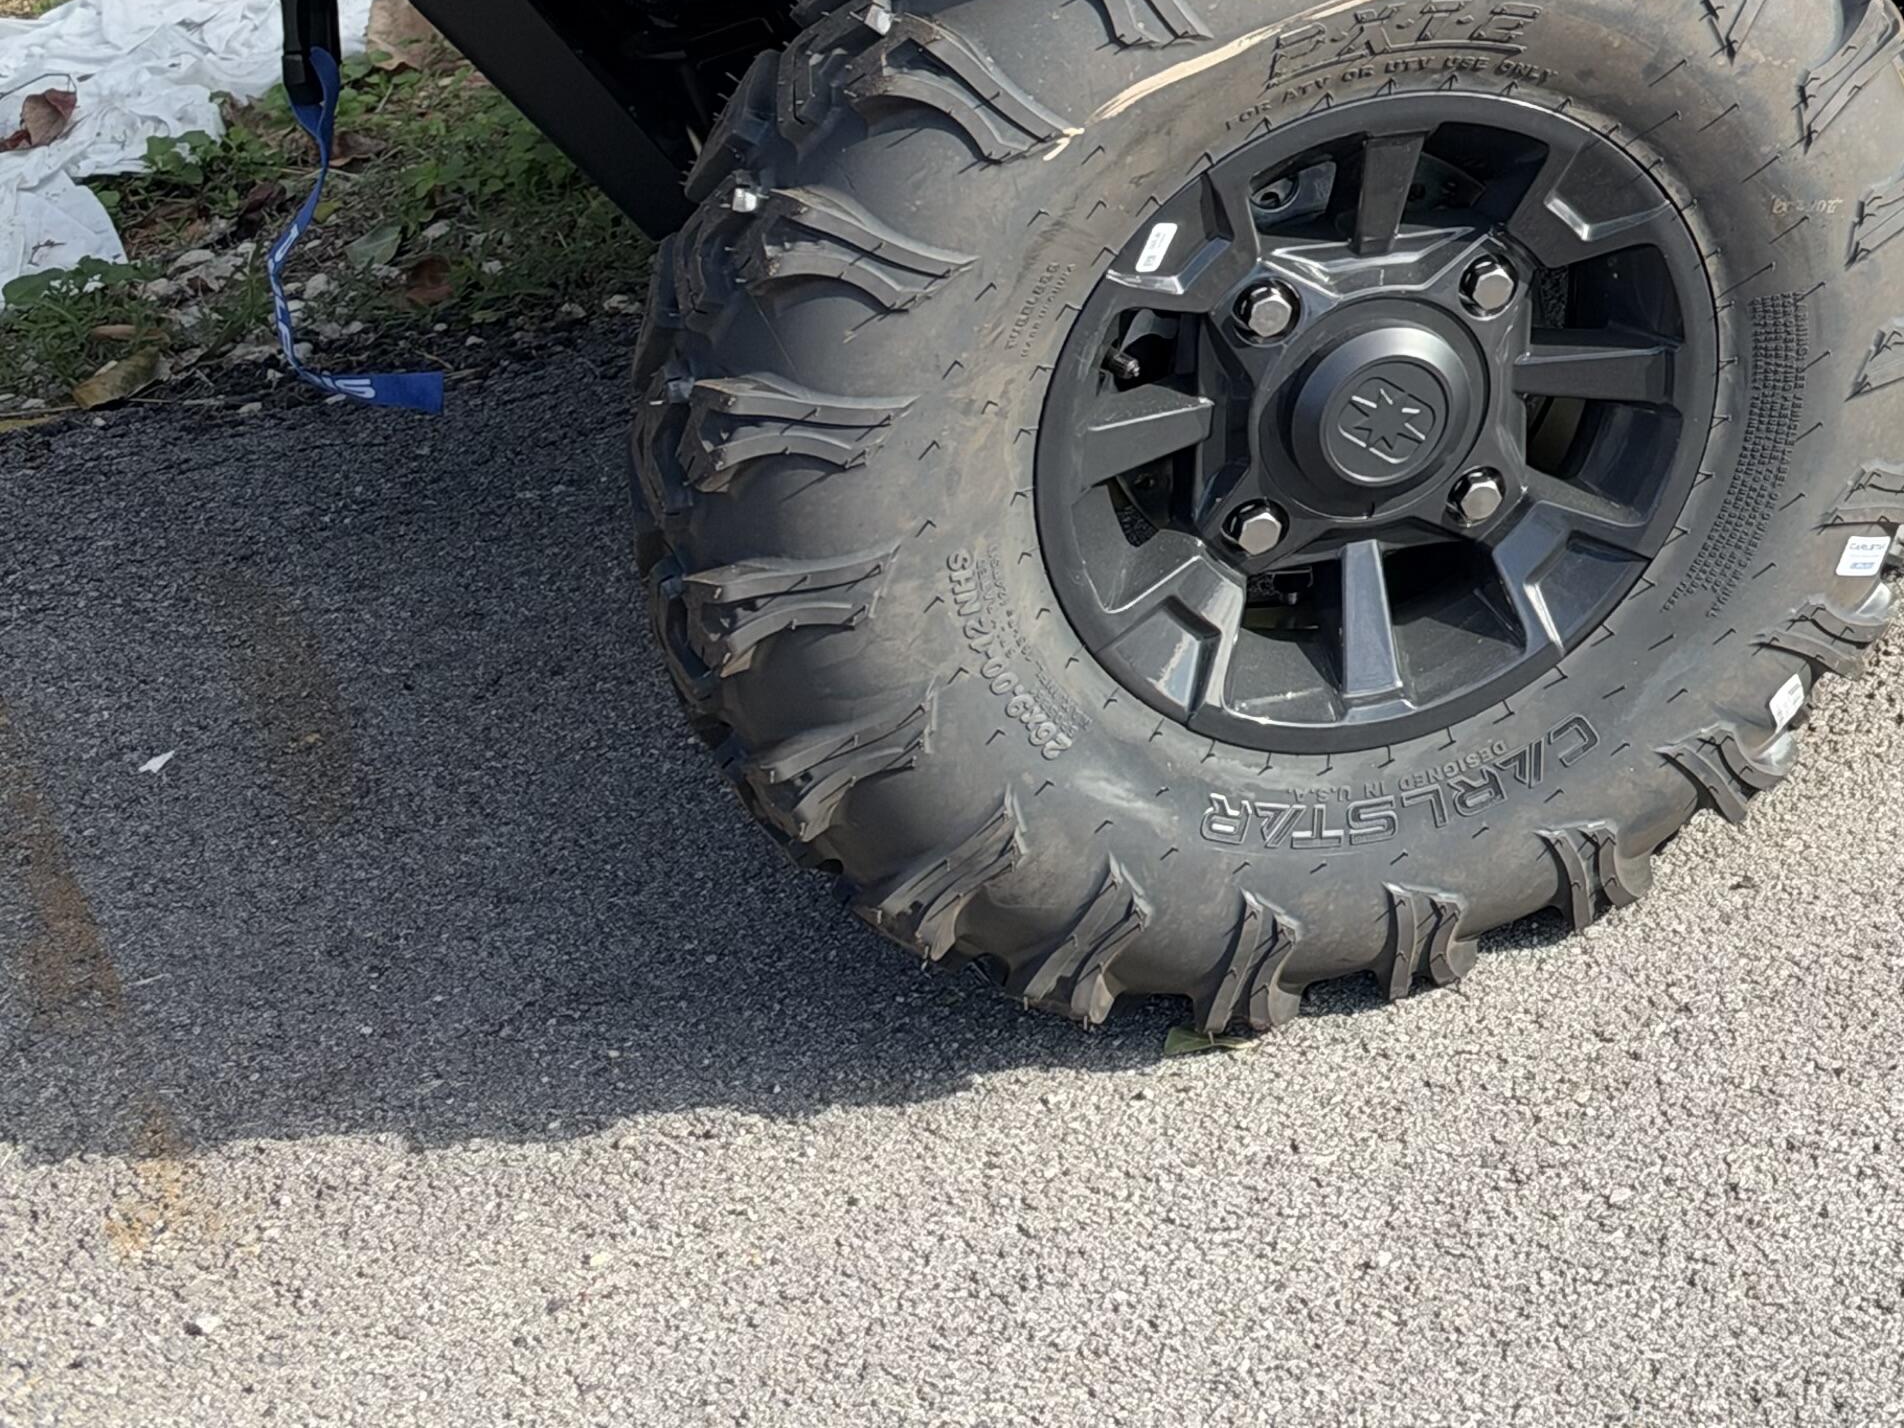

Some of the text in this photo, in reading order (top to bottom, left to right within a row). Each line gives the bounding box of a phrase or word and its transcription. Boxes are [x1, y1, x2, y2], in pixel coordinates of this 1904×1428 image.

[1225, 55, 1557, 131] FOR ATV OR UTV USE ONLY
[946, 547, 982, 617] NHS
[1200, 713, 1600, 850] CARLSTAR
[1286, 739, 1505, 802] DESIGNED IN U.S.A.
